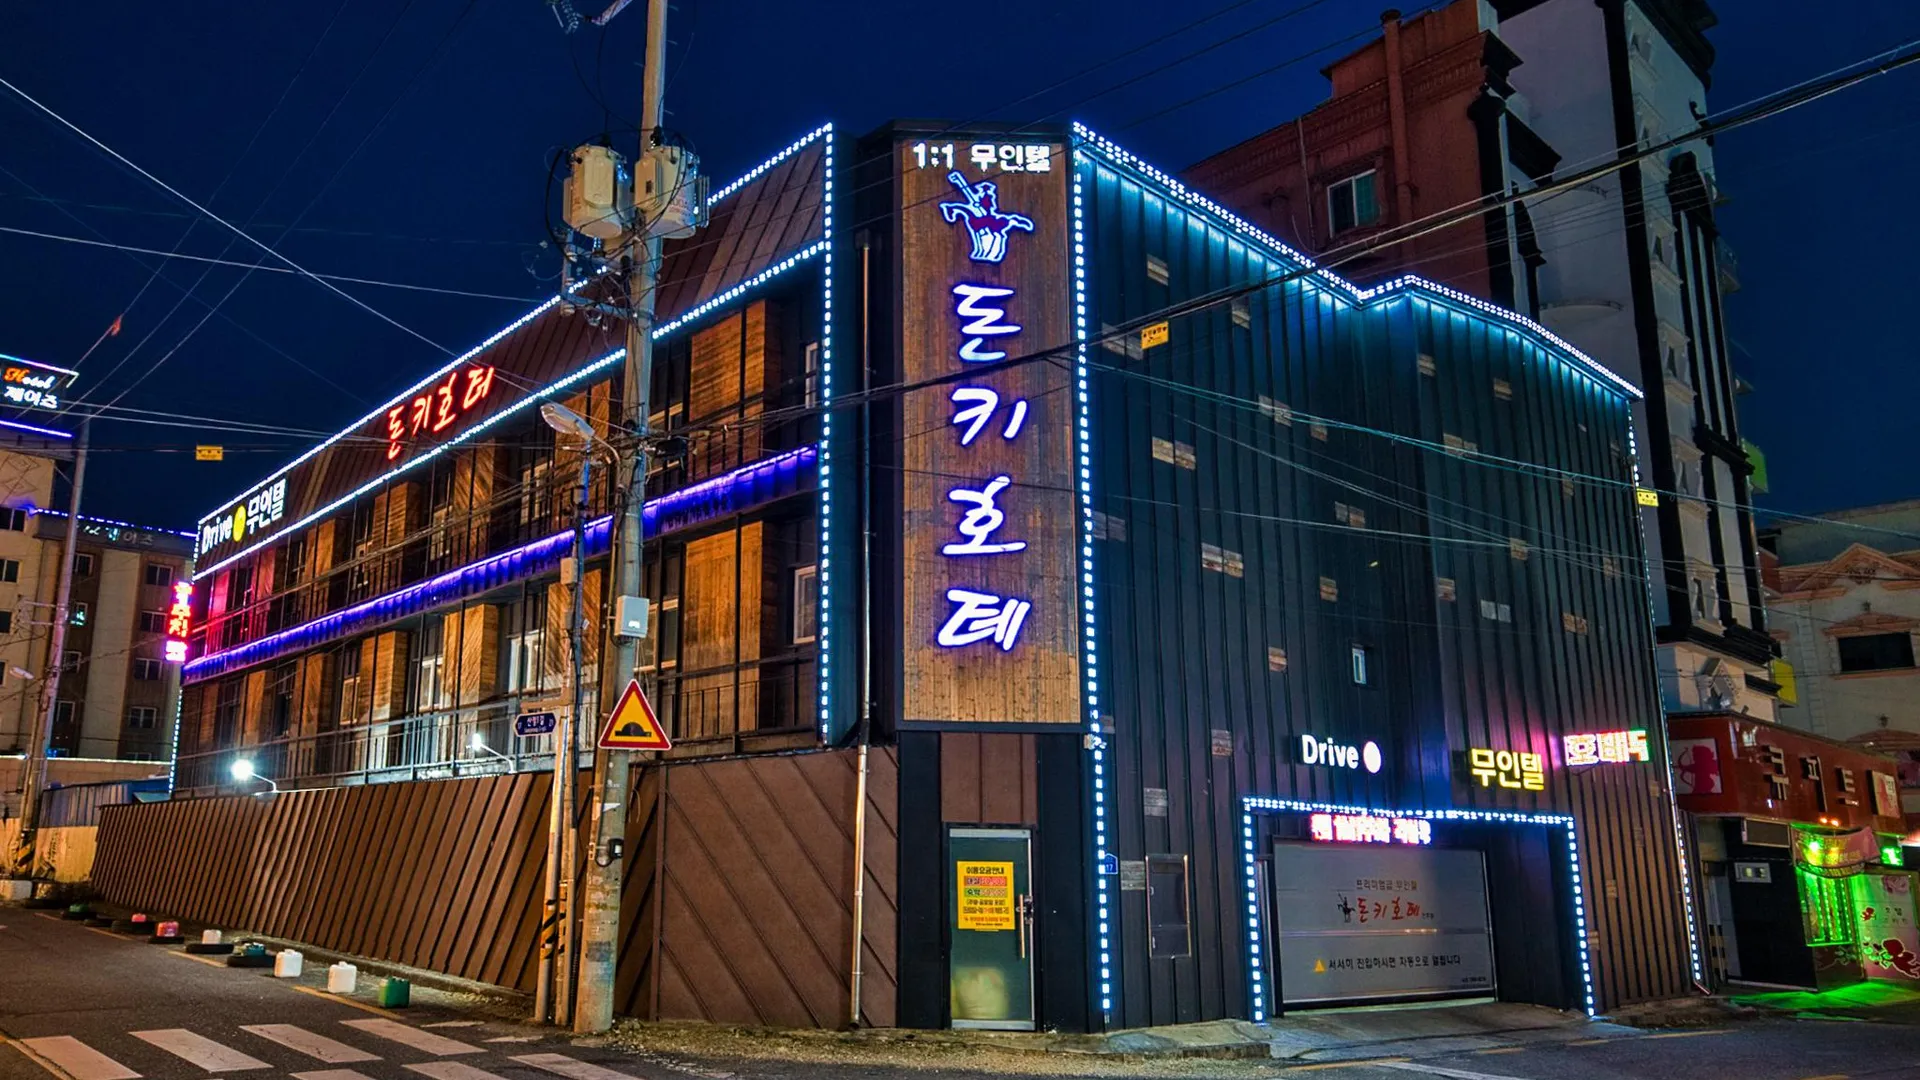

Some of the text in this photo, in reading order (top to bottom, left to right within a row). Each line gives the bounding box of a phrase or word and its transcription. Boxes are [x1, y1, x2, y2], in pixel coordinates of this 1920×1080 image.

[913, 143, 1051, 172] 1:1 무인텔
[4, 367, 55, 389] Hotel
[4, 386, 58, 408] 제이즈
[937, 283, 1033, 653] 돈키호테
[201, 478, 287, 554] Drive 무인텔
[1301, 734, 1359, 769] Drive
[1471, 748, 1545, 791] 무인텔
[1357, 896, 1421, 924] 돈키호테
[1328, 959, 1354, 970] 서서히
[1399, 956, 1430, 968] 자동으로
